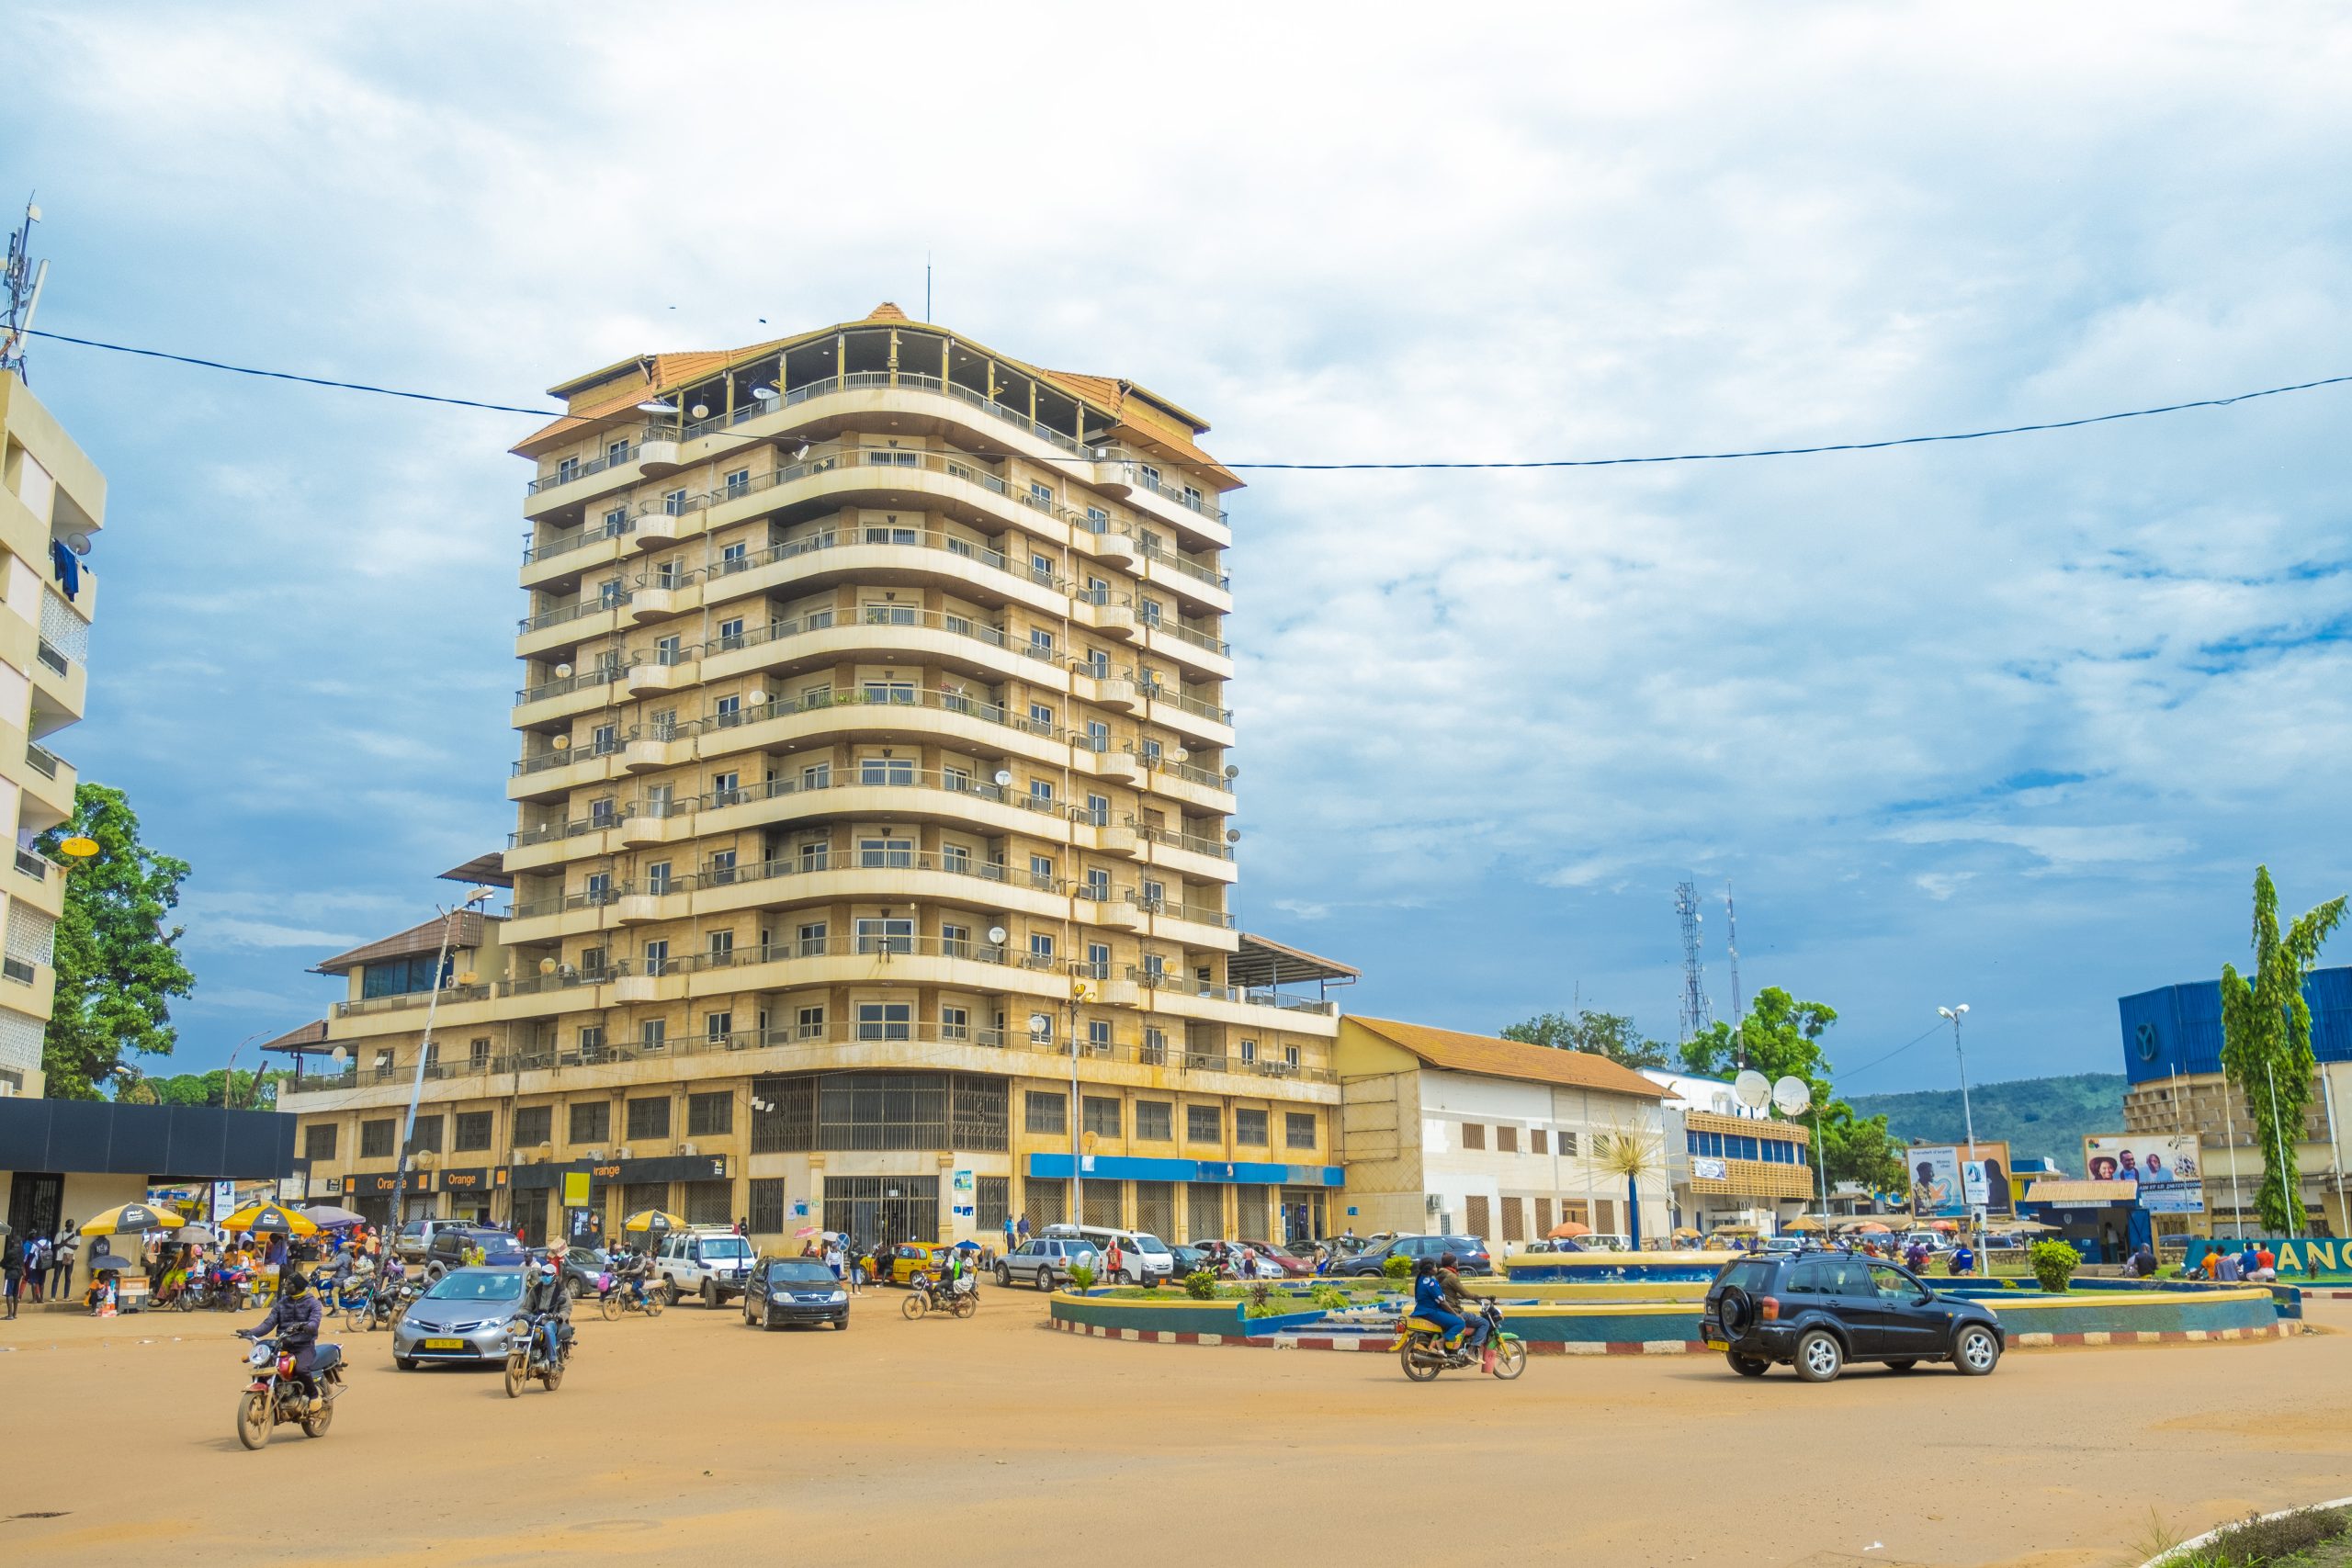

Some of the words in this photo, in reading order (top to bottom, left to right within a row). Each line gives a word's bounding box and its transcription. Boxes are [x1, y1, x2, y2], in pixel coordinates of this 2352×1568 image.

[593, 1165, 620, 1178] range
[377, 1177, 407, 1190] Orane
[448, 1174, 476, 1187] Orange
